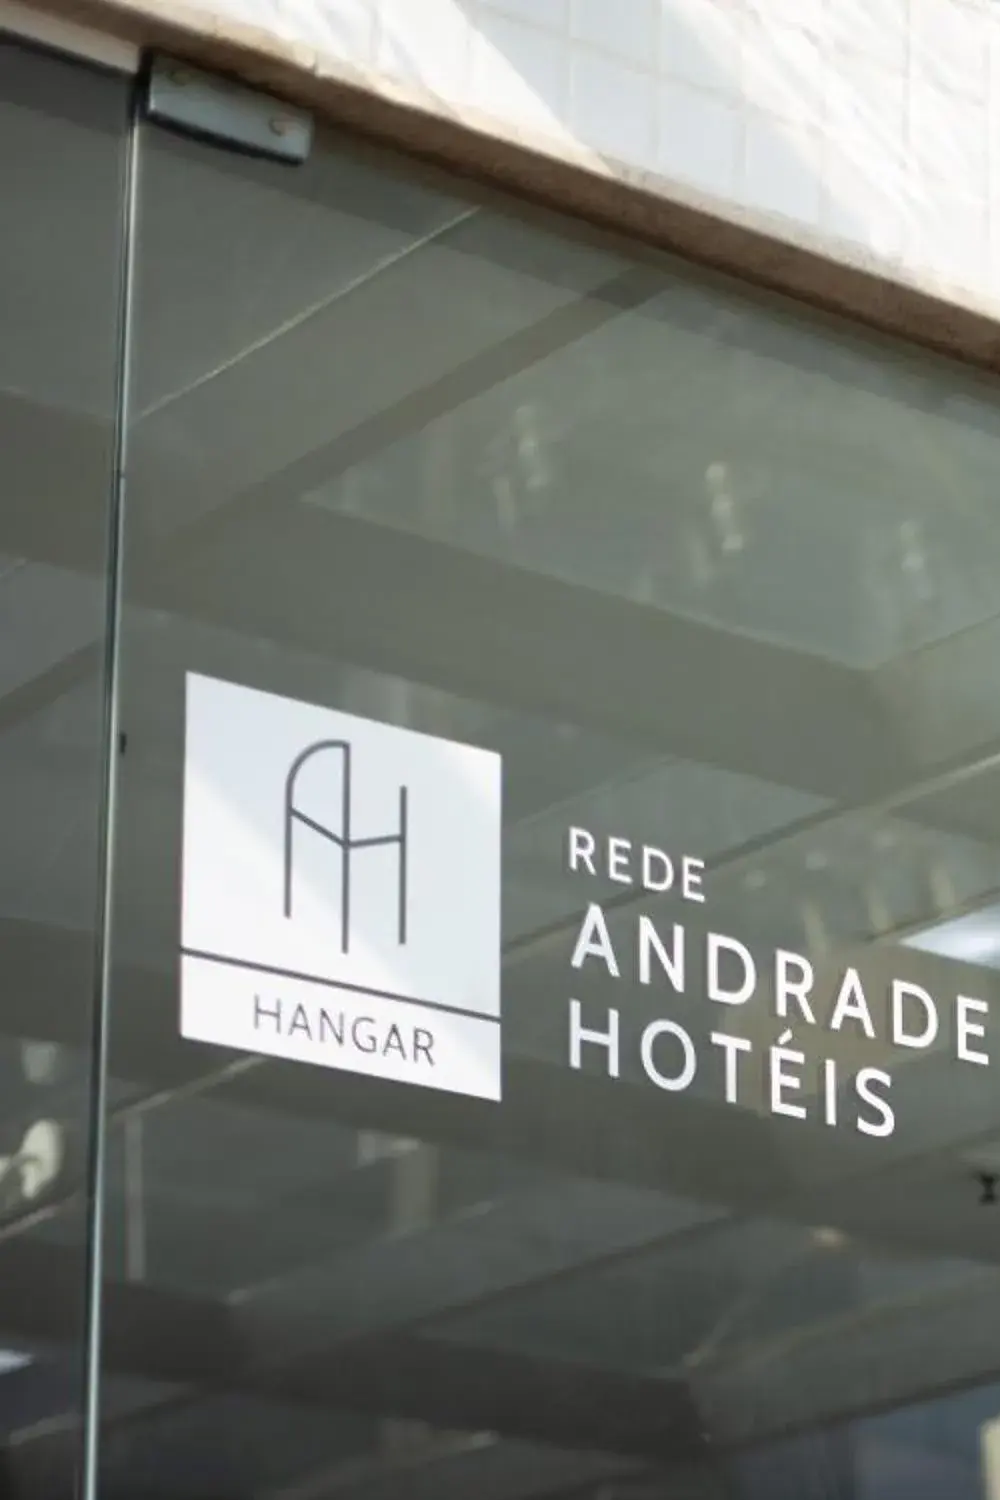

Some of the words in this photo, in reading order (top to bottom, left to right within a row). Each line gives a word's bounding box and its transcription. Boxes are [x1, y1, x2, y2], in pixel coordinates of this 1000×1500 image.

[568, 826, 706, 903] REDE
[253, 994, 437, 1067] HANGAR
[570, 903, 990, 1066] ANDRADE
[568, 999, 896, 1137] HOTÉIS
